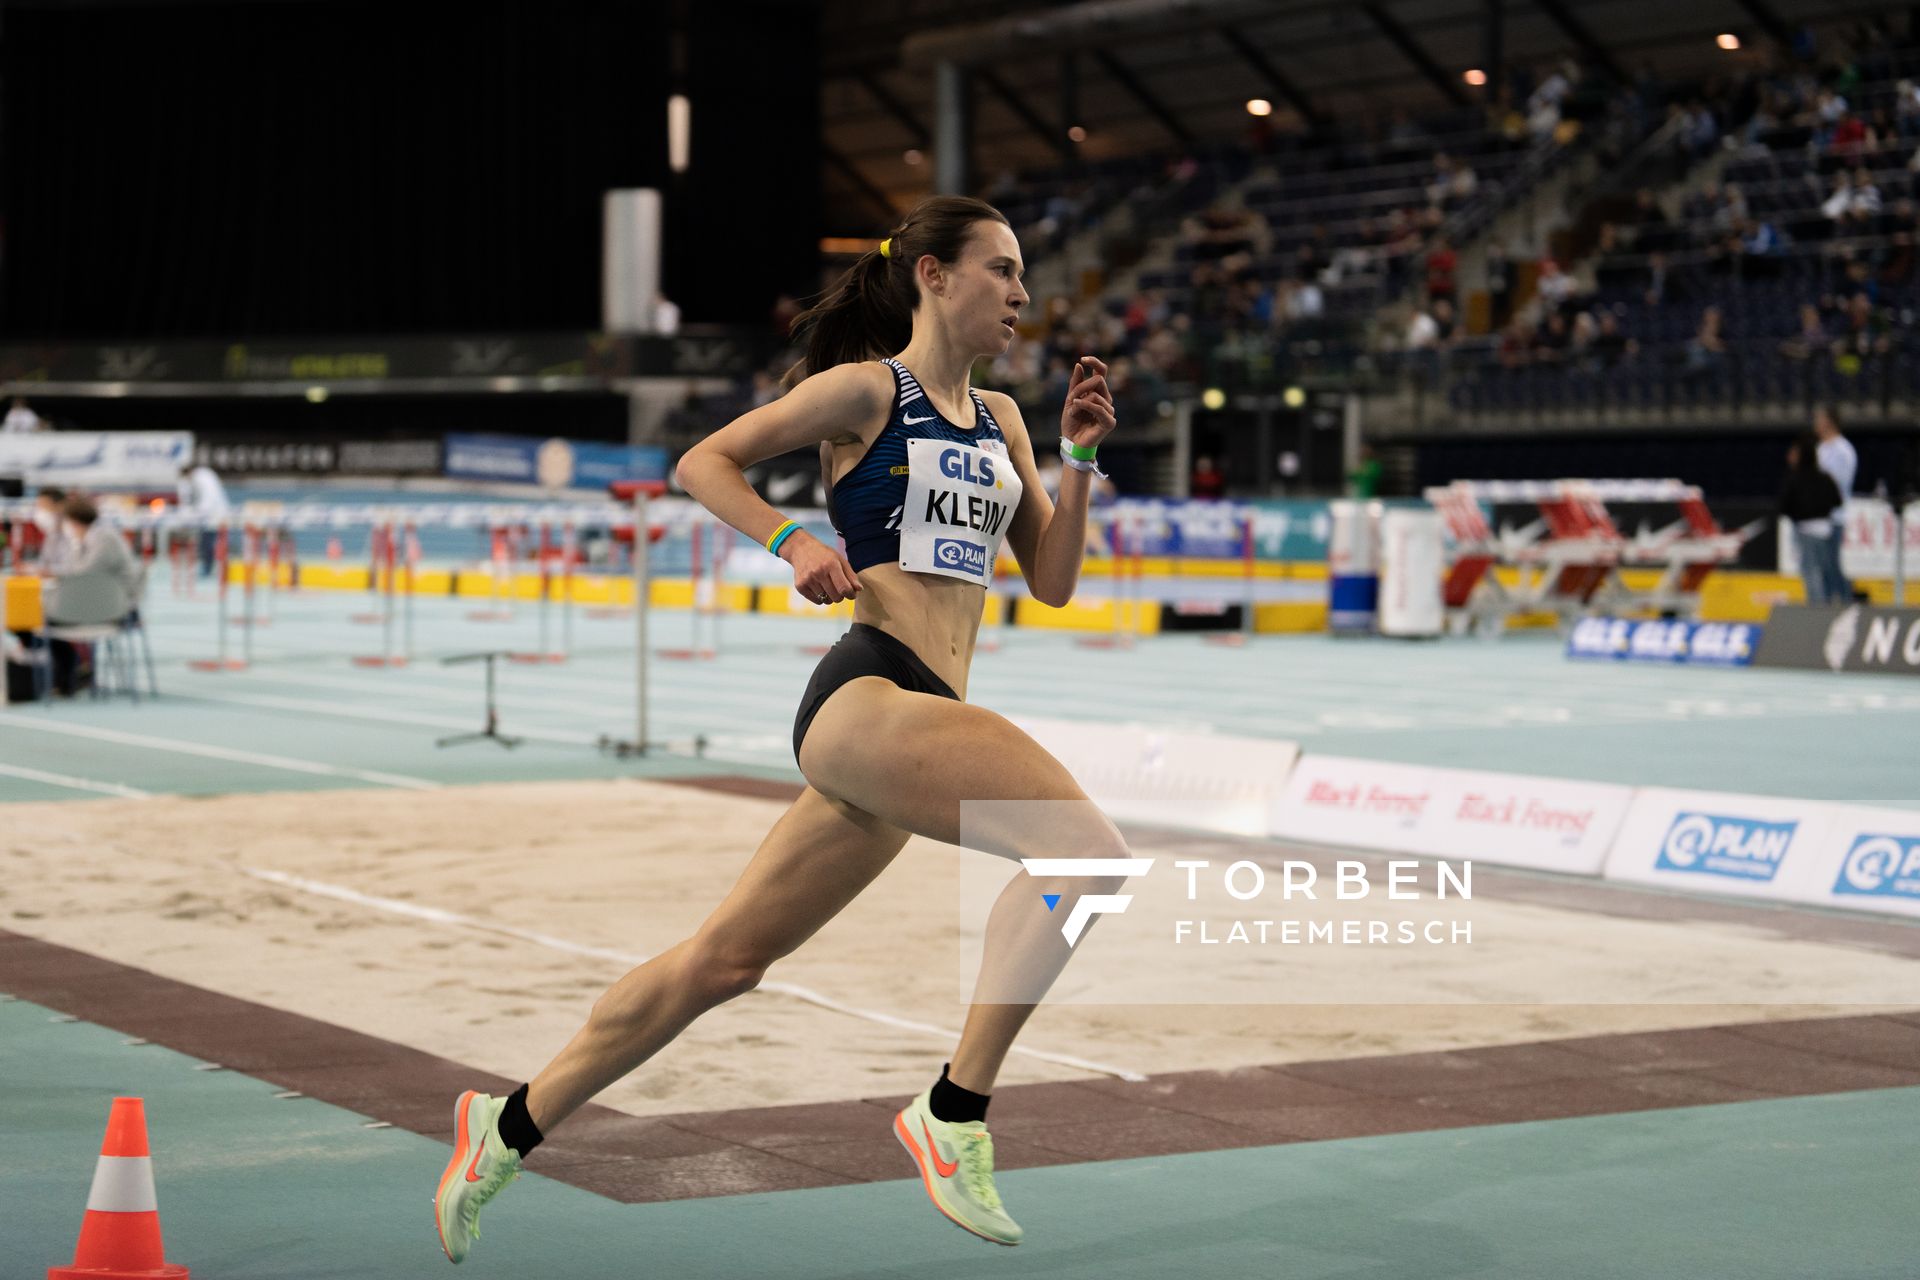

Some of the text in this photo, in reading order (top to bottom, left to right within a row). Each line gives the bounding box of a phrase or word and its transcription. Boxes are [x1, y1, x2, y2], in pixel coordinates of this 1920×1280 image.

[925, 489, 1007, 536] KLEIN
[964, 547, 984, 566] PLAN
[1711, 824, 1788, 863] PLAN
